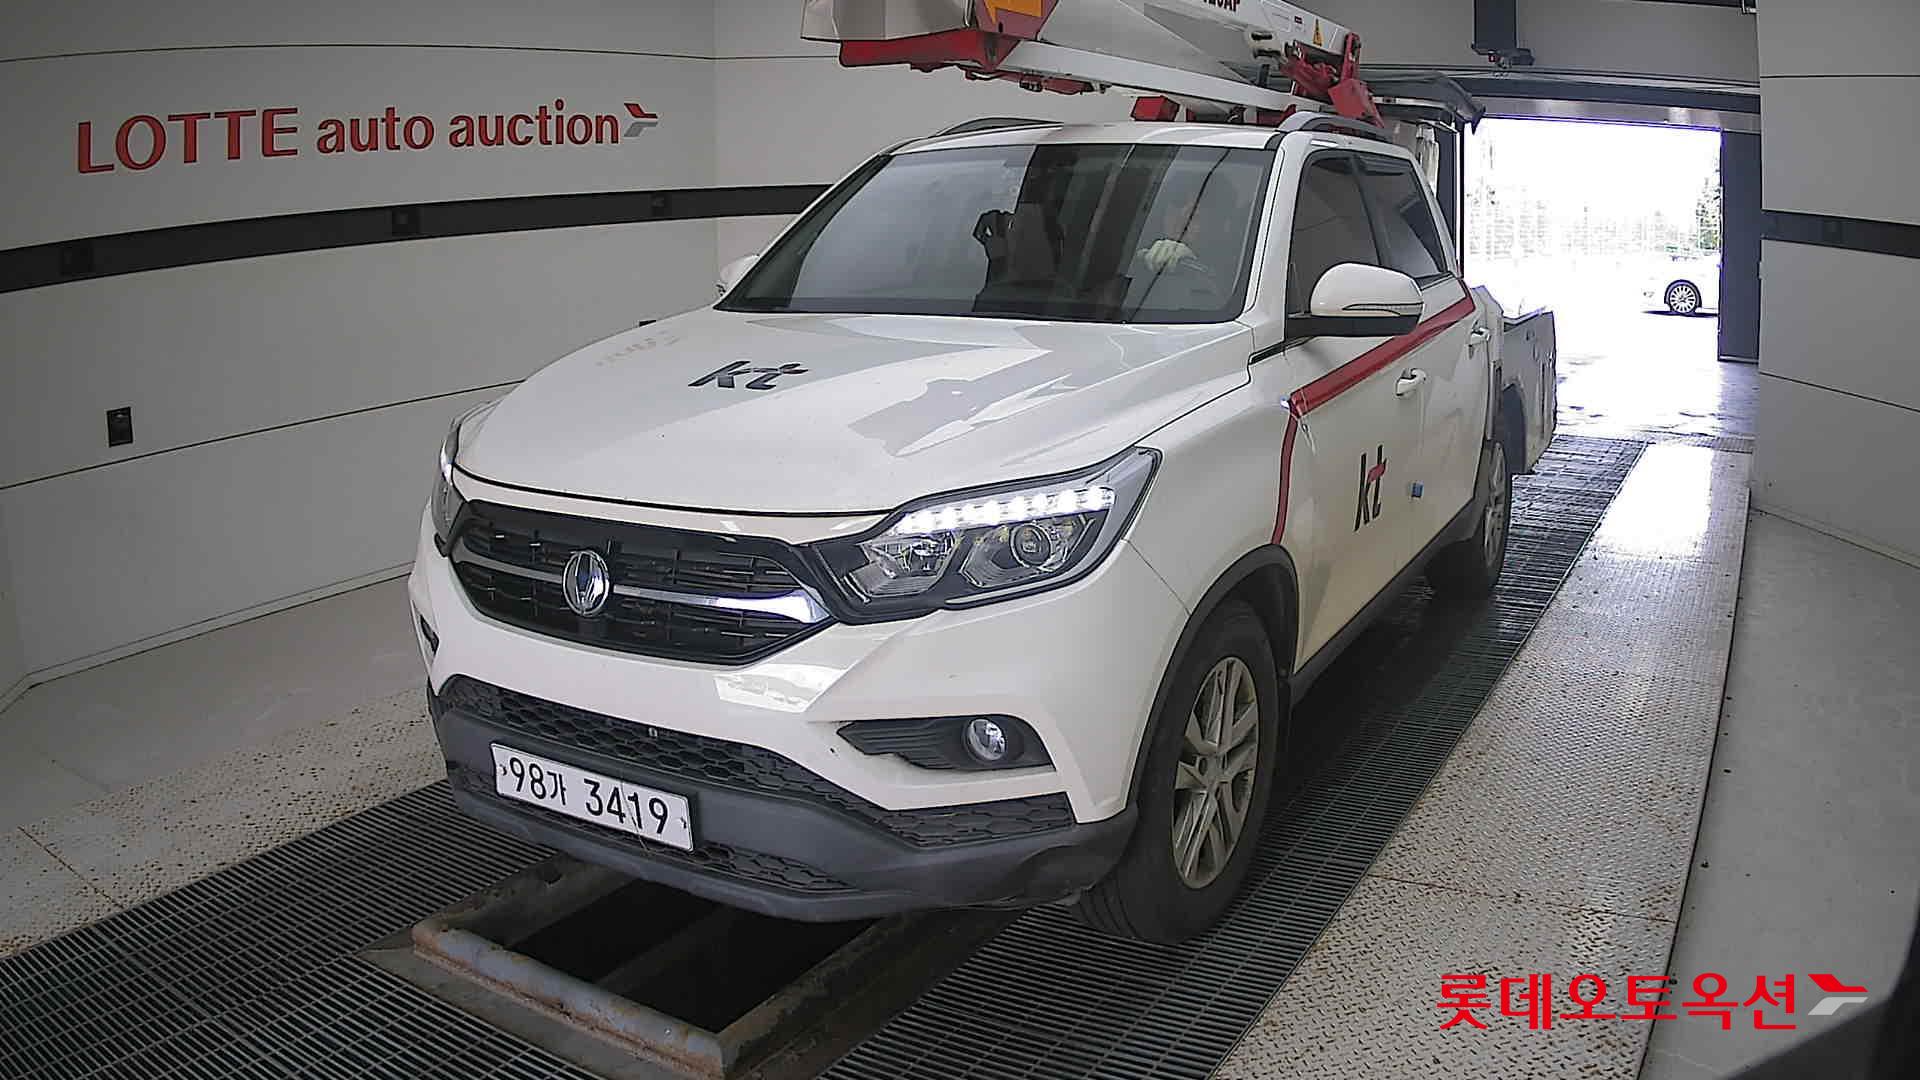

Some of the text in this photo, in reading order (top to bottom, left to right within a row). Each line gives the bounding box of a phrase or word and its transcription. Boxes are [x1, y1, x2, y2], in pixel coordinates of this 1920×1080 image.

[78, 99, 621, 173] LOTTE auto auction
[687, 360, 809, 390] kt
[1353, 444, 1388, 533] kt
[508, 756, 668, 835] 98가 3419
